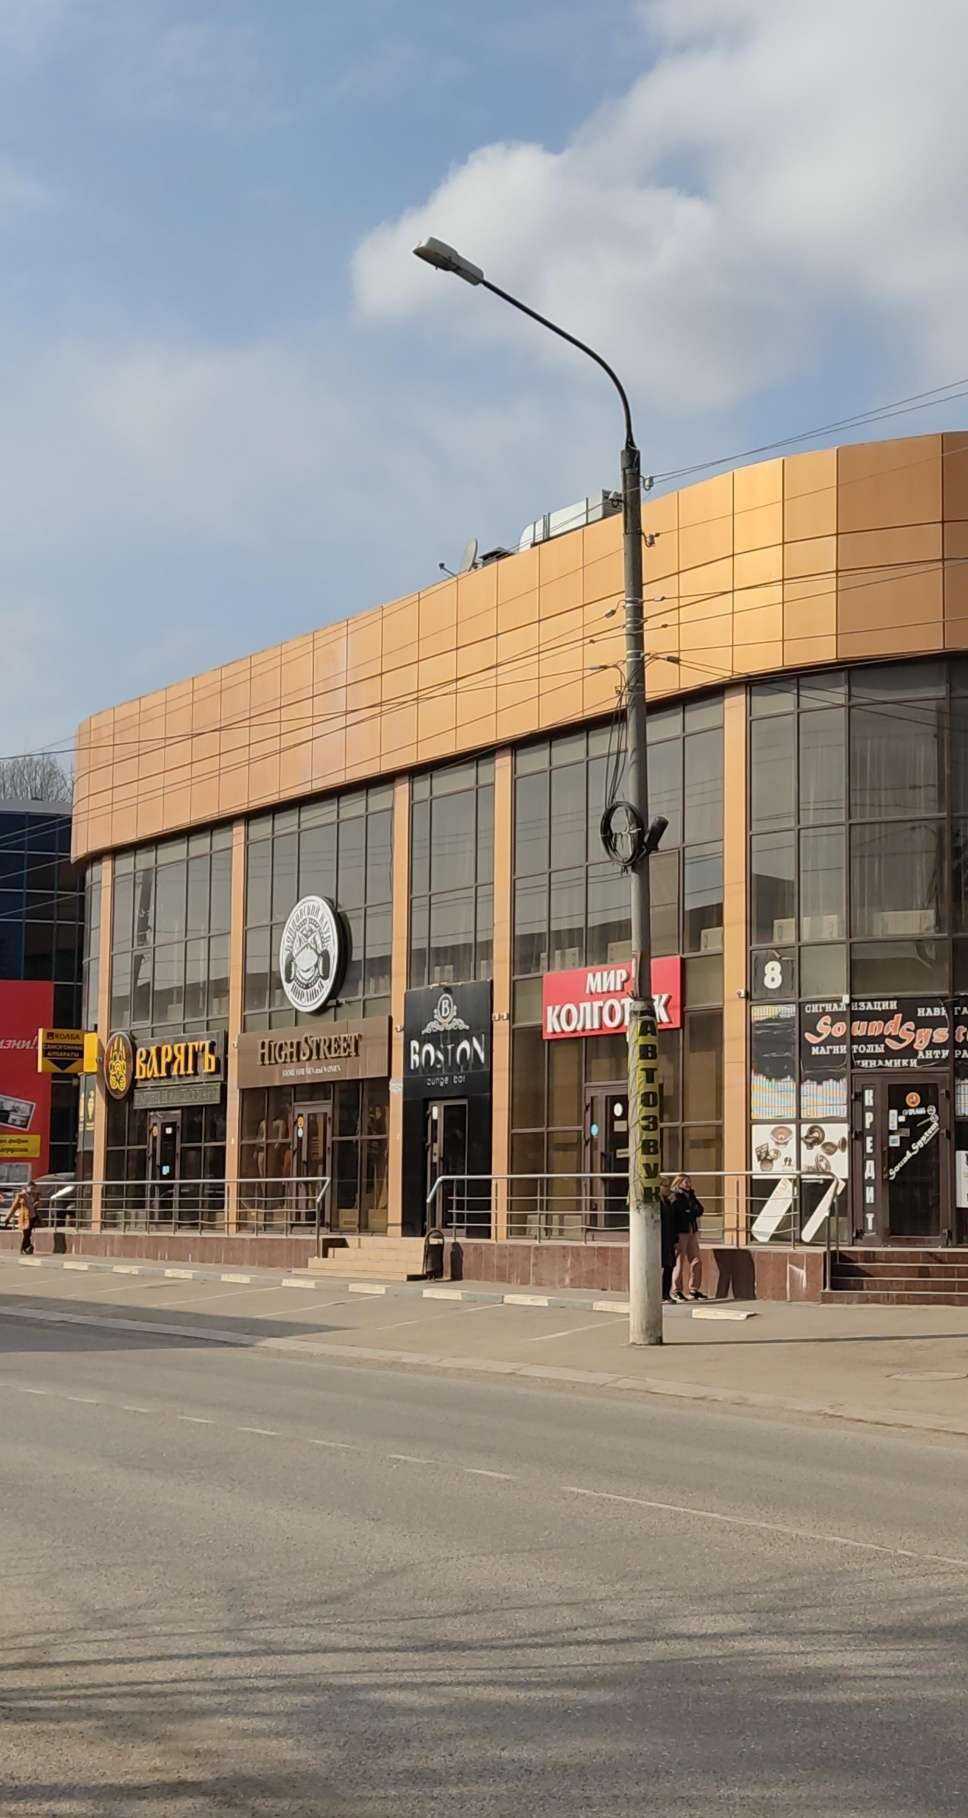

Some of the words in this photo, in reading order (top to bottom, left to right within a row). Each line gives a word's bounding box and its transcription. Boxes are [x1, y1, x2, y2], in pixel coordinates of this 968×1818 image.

[586, 969, 628, 994] МИР
[763, 960, 782, 989] 8
[441, 999, 450, 1018] B
[546, 993, 672, 1033] КОЛГОТК
[135, 1040, 217, 1079] ВАРЯГЪ
[257, 1038, 300, 1065] HIGH
[300, 1032, 363, 1062] STREET
[410, 1033, 485, 1070] BOSTON
[812, 1044, 886, 1055] МАГНИТОЛЫ
[638, 1020, 660, 1202] АВТОЗВУК
[864, 1089, 876, 1231] КРЕДИТ
